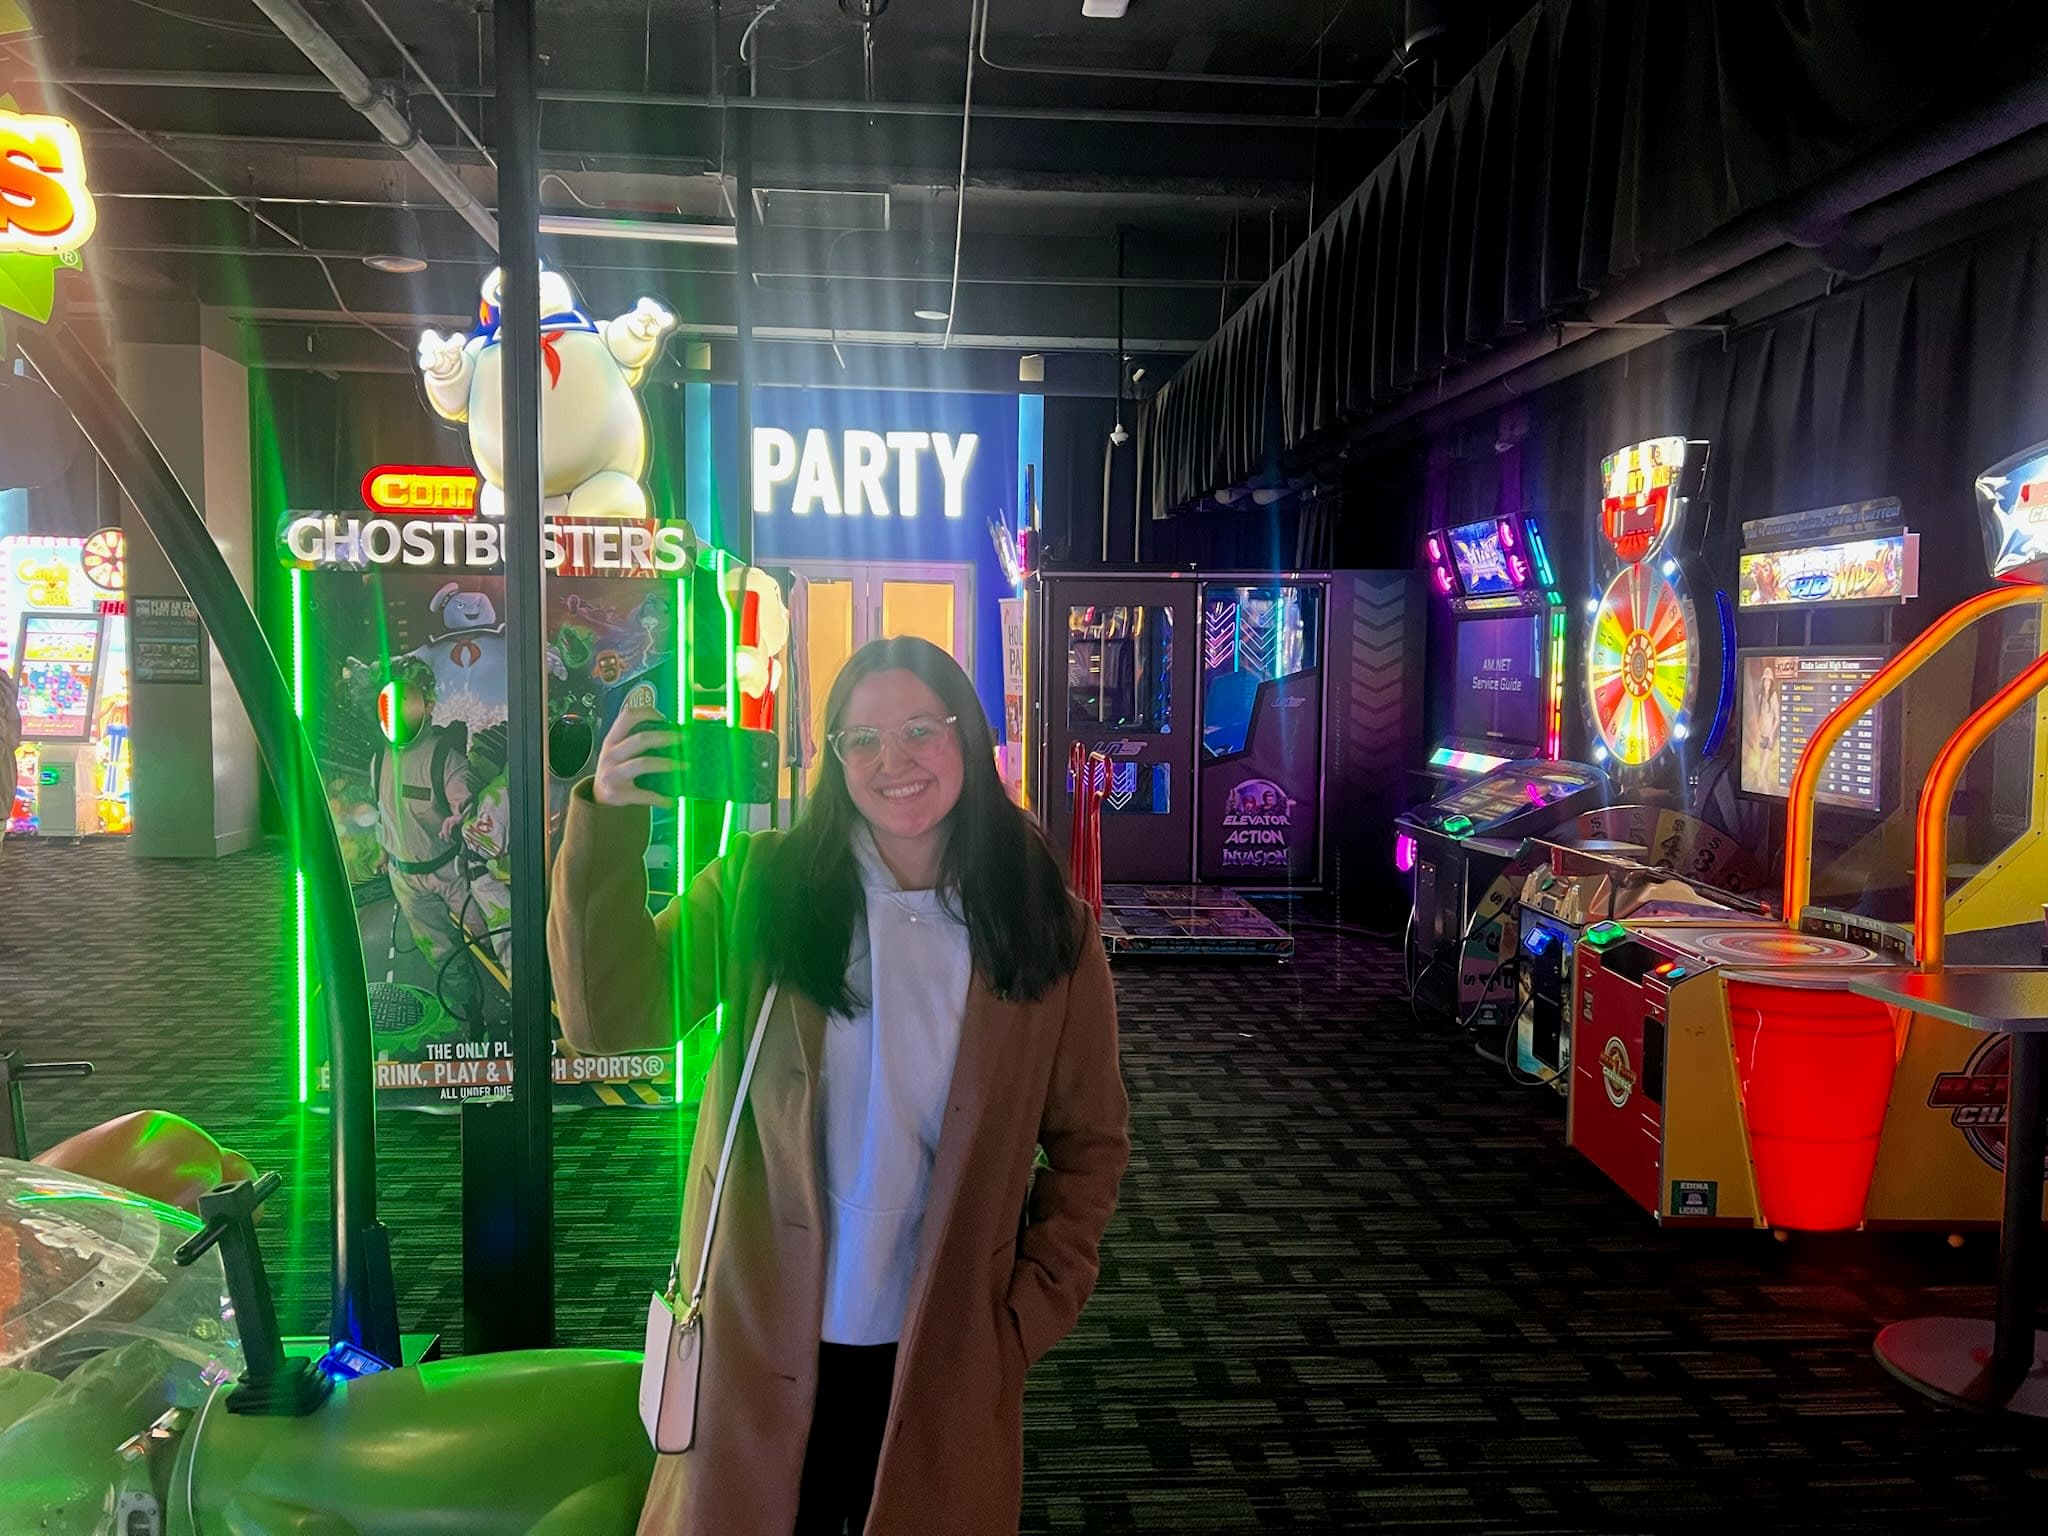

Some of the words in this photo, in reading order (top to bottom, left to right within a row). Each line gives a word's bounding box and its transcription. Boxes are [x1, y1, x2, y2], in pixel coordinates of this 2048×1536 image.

[753, 427, 979, 518] PARTY
[287, 517, 688, 573] GHOSTBSTERS
[1482, 658, 1512, 672] AM.NET
[1471, 676, 1499, 691] Service
[1500, 677, 1521, 691] Guide
[1222, 814, 1292, 826] ELEVATOR
[1224, 829, 1286, 845] ACTION
[1222, 848, 1289, 867] INVASION
[426, 1043, 451, 1060] THE
[455, 1042, 490, 1059] ONLY
[377, 1063, 428, 1087] RINK,
[434, 1061, 479, 1084] PLAY
[486, 1061, 500, 1083] &
[440, 1087, 457, 1100] ALL
[493, 1086, 512, 1097] ONE
[1680, 1182, 1709, 1190] EDINA
